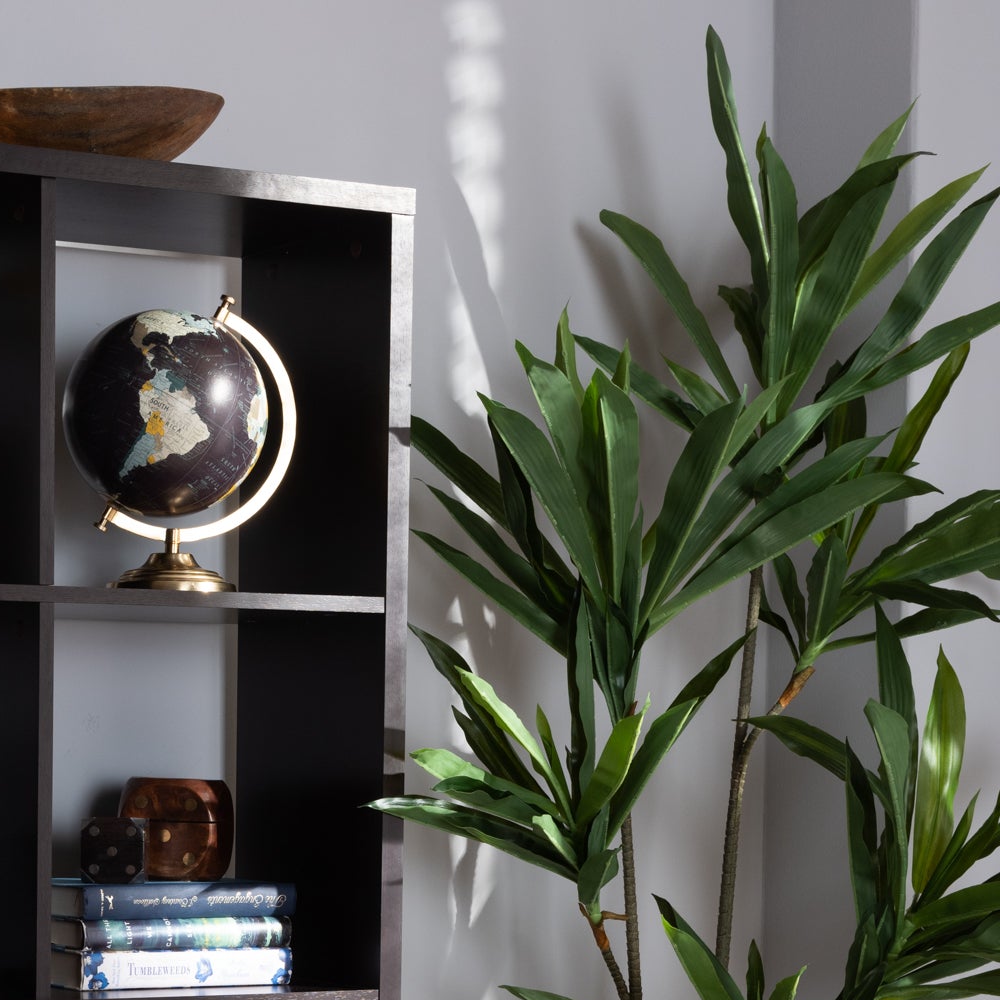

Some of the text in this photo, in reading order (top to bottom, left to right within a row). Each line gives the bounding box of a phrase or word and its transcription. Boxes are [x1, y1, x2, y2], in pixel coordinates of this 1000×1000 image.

[150, 397, 170, 412] SOUTH
[208, 892, 287, 910] The Engagements
[124, 921, 133, 944] LIGHT
[128, 962, 190, 976] TUMBLEWEEDS
